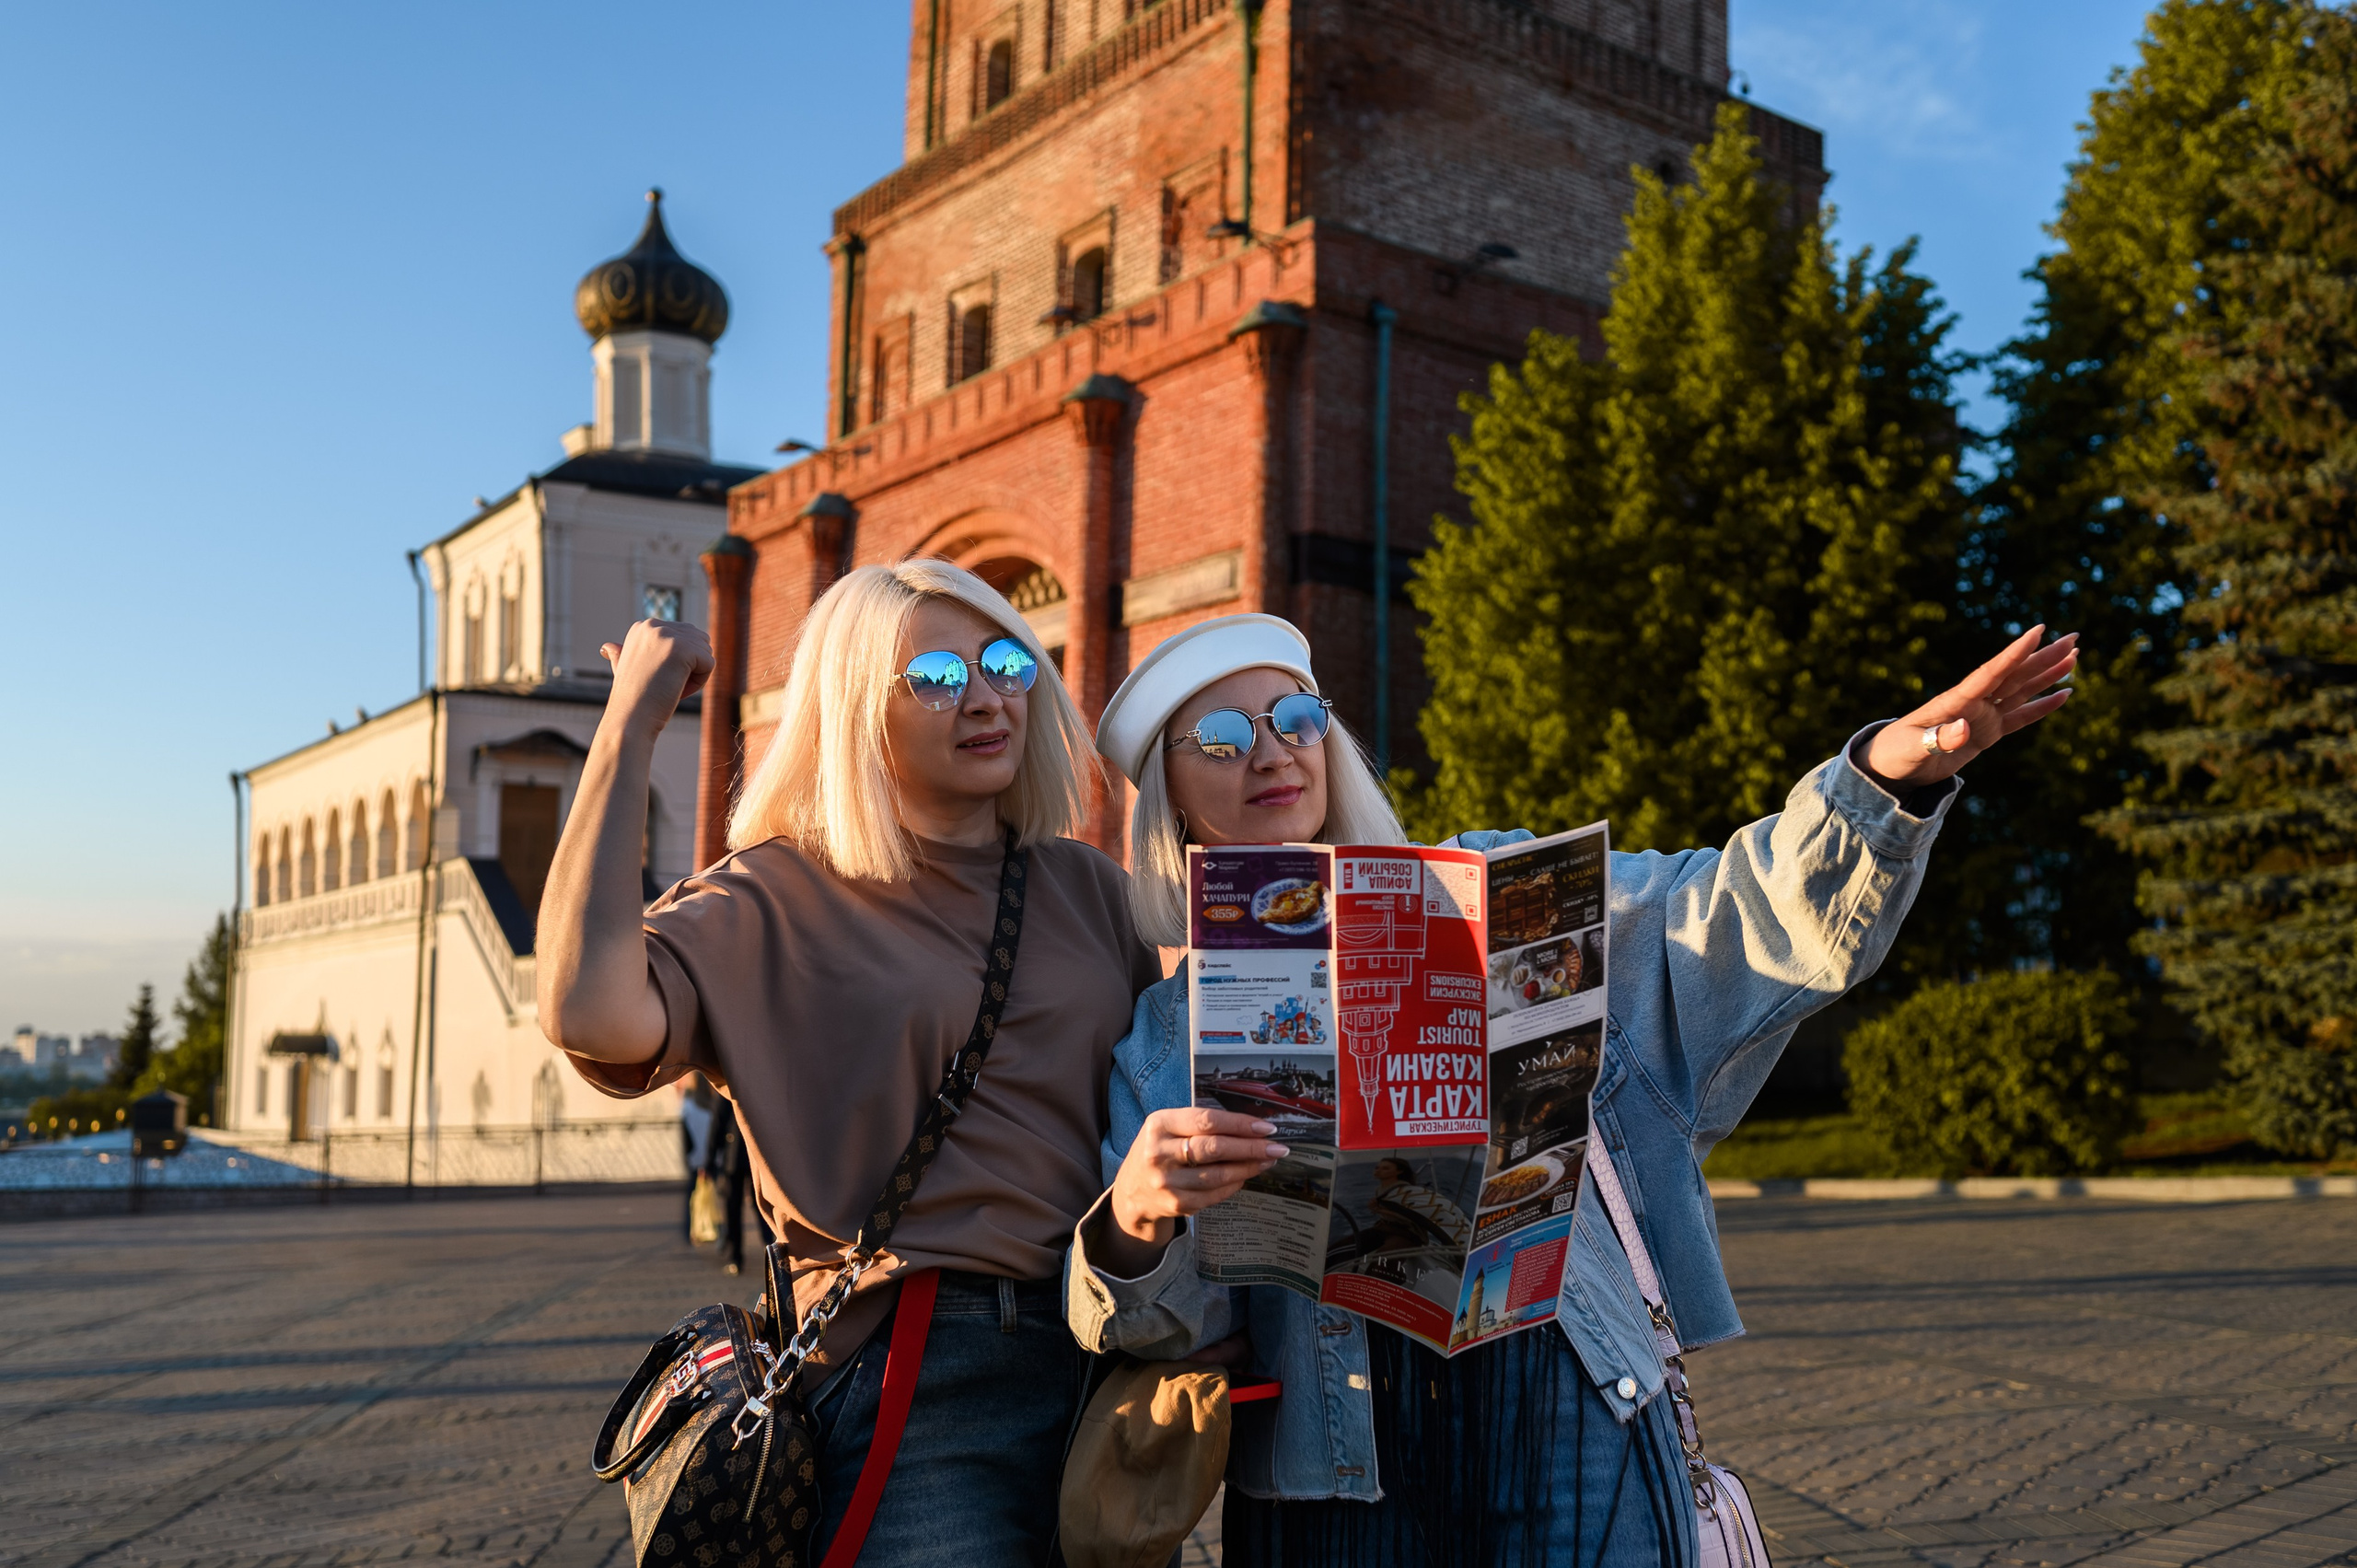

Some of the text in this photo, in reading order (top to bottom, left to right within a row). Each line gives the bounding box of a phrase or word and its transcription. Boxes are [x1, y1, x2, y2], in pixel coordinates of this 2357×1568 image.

[1358, 862, 1412, 878] СОБЫТИЙ
[1558, 861, 1568, 870] НЕ
[1202, 881, 1234, 891] Любой
[1368, 876, 1412, 890] АФИША
[1202, 893, 1250, 903] ХАЧАПУРИ
[1430, 974, 1482, 988] EXCURSIONS
[1430, 987, 1482, 1001] ЭКСКУРСИИ
[1446, 1007, 1481, 1027] MAP
[1416, 1026, 1481, 1047] TOURIST
[1517, 1042, 1575, 1075] УМАЙ
[1386, 1053, 1483, 1082] КАЗАНИ
[1388, 1084, 1483, 1119] КАРТА
[1409, 1121, 1481, 1133] ТУРИСТИЧЕСКАЯ
[1479, 1205, 1518, 1229] ESHAK
